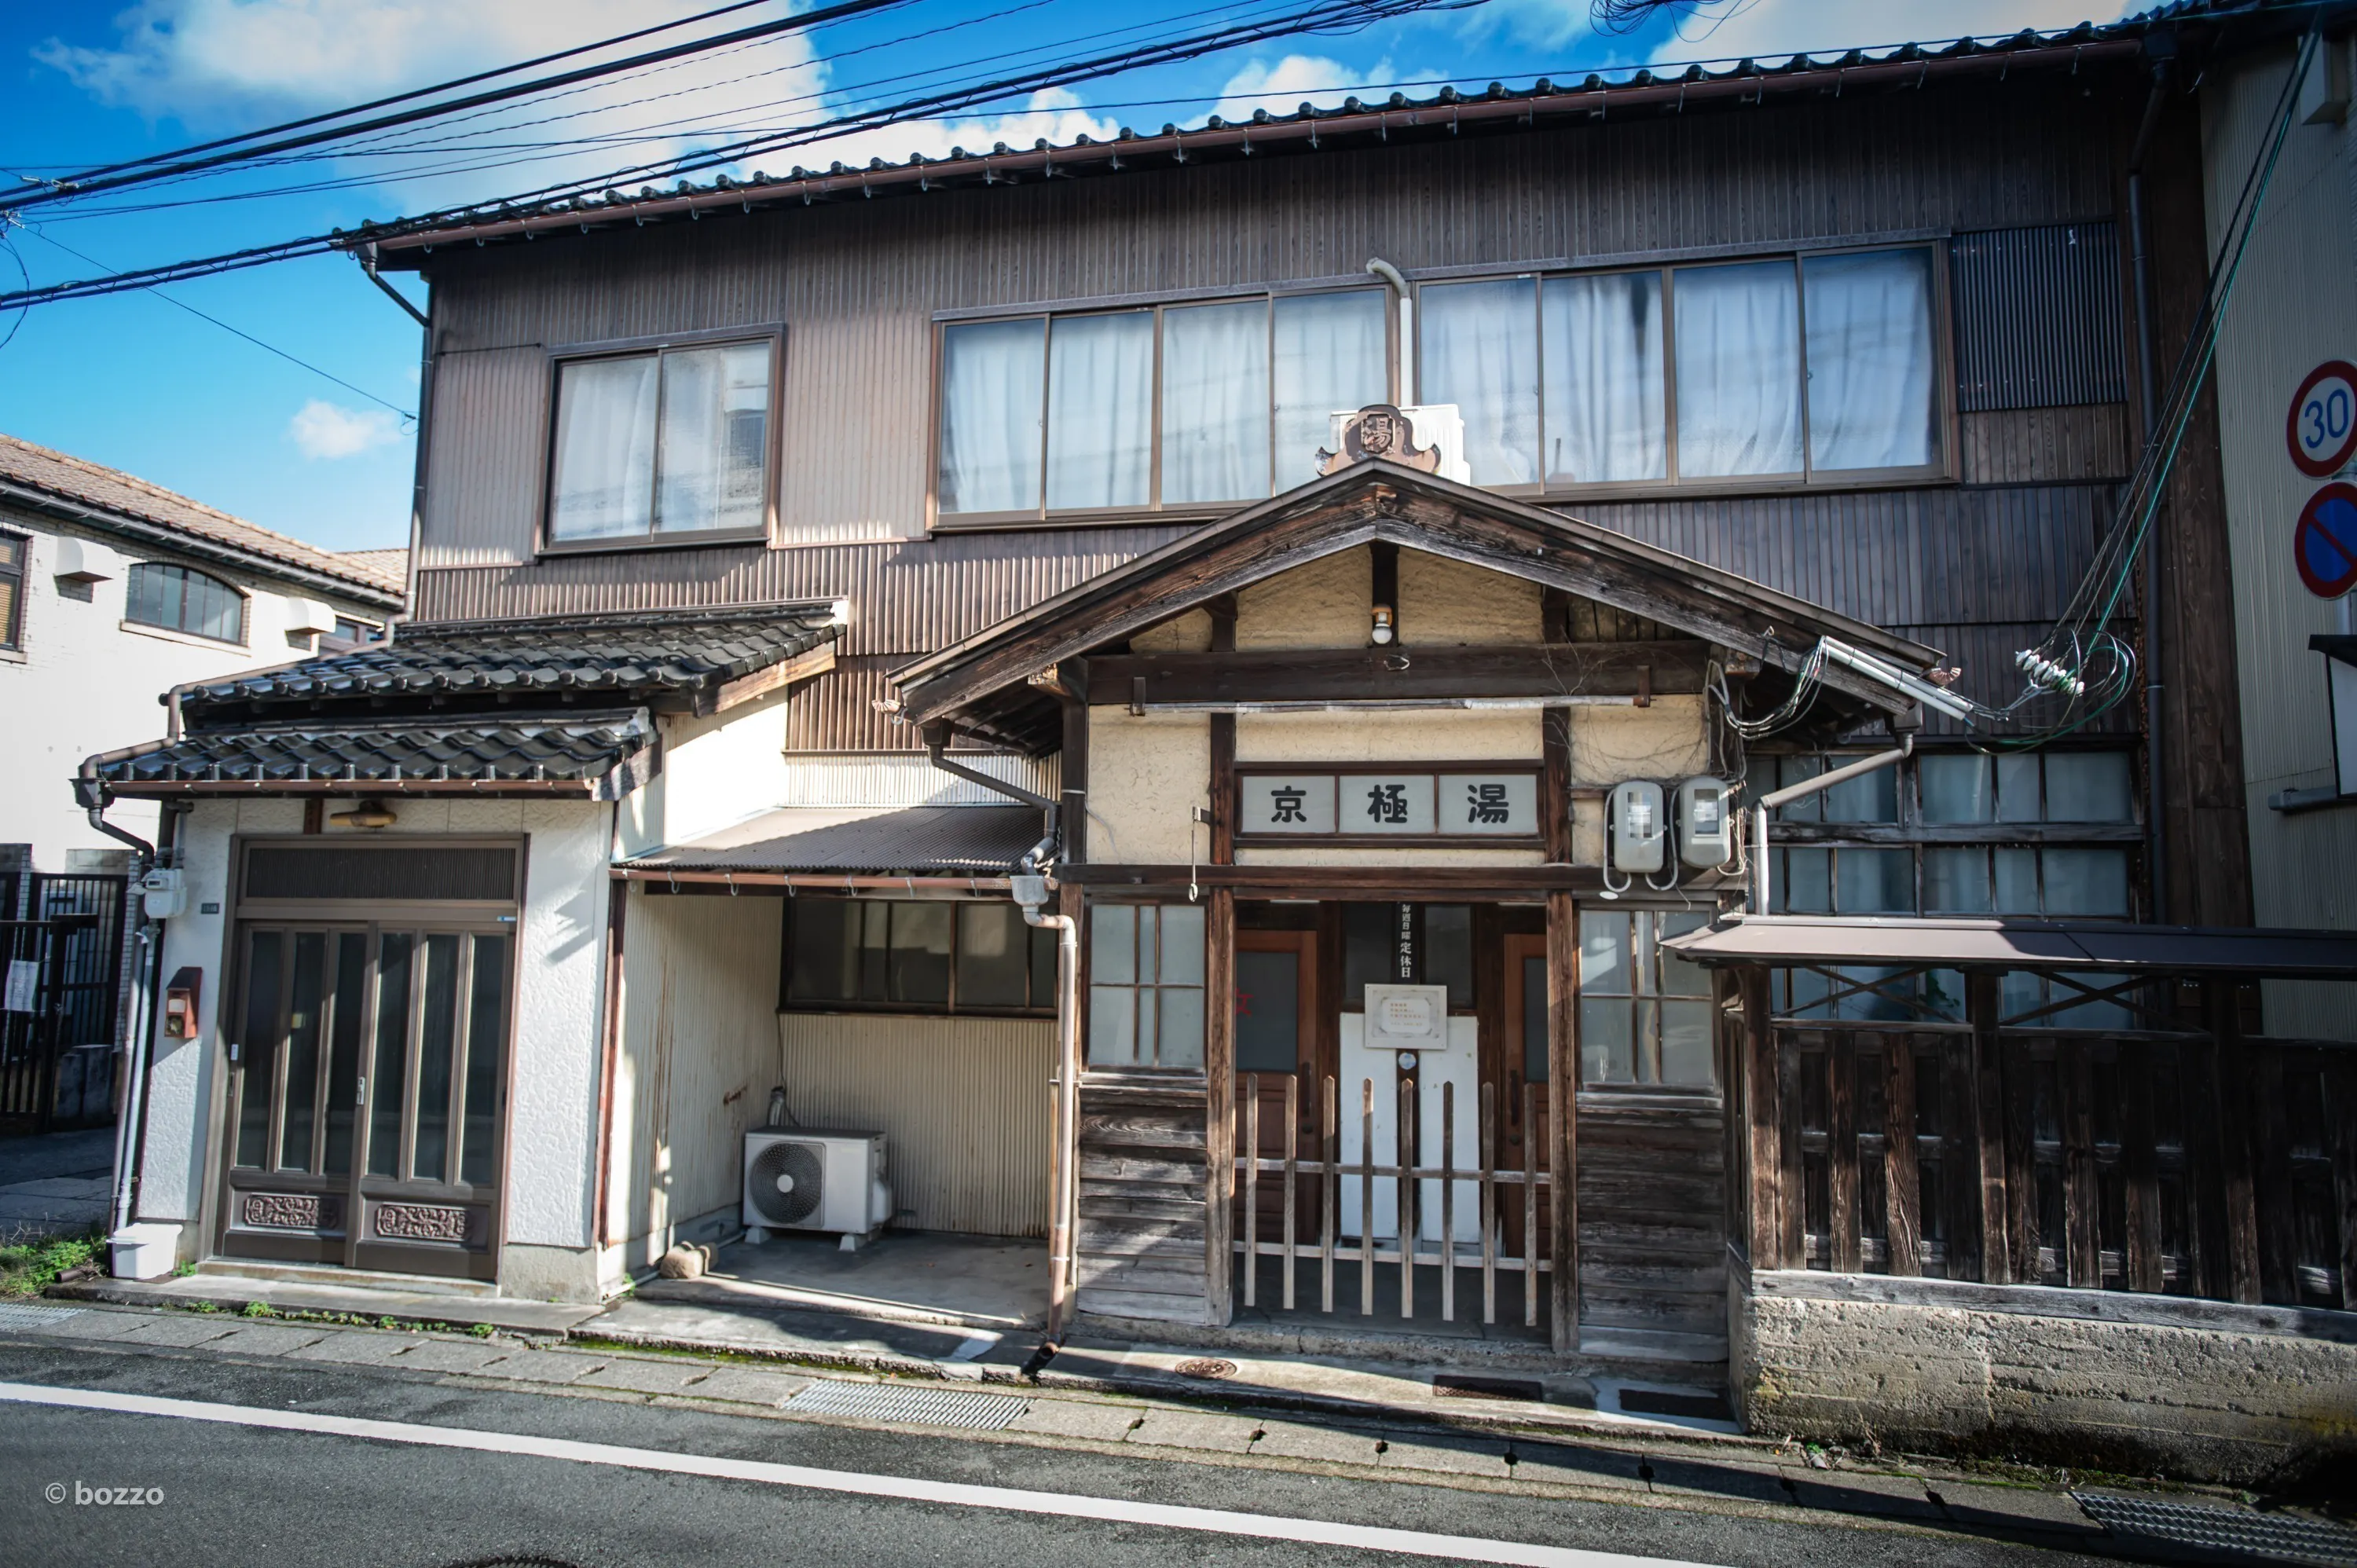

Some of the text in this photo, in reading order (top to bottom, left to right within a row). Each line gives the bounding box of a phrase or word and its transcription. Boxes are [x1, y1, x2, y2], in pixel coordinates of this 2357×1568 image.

[1364, 417, 1391, 449] 湯
[2304, 389, 2349, 449] 30
[1270, 784, 1509, 823] 京極湯
